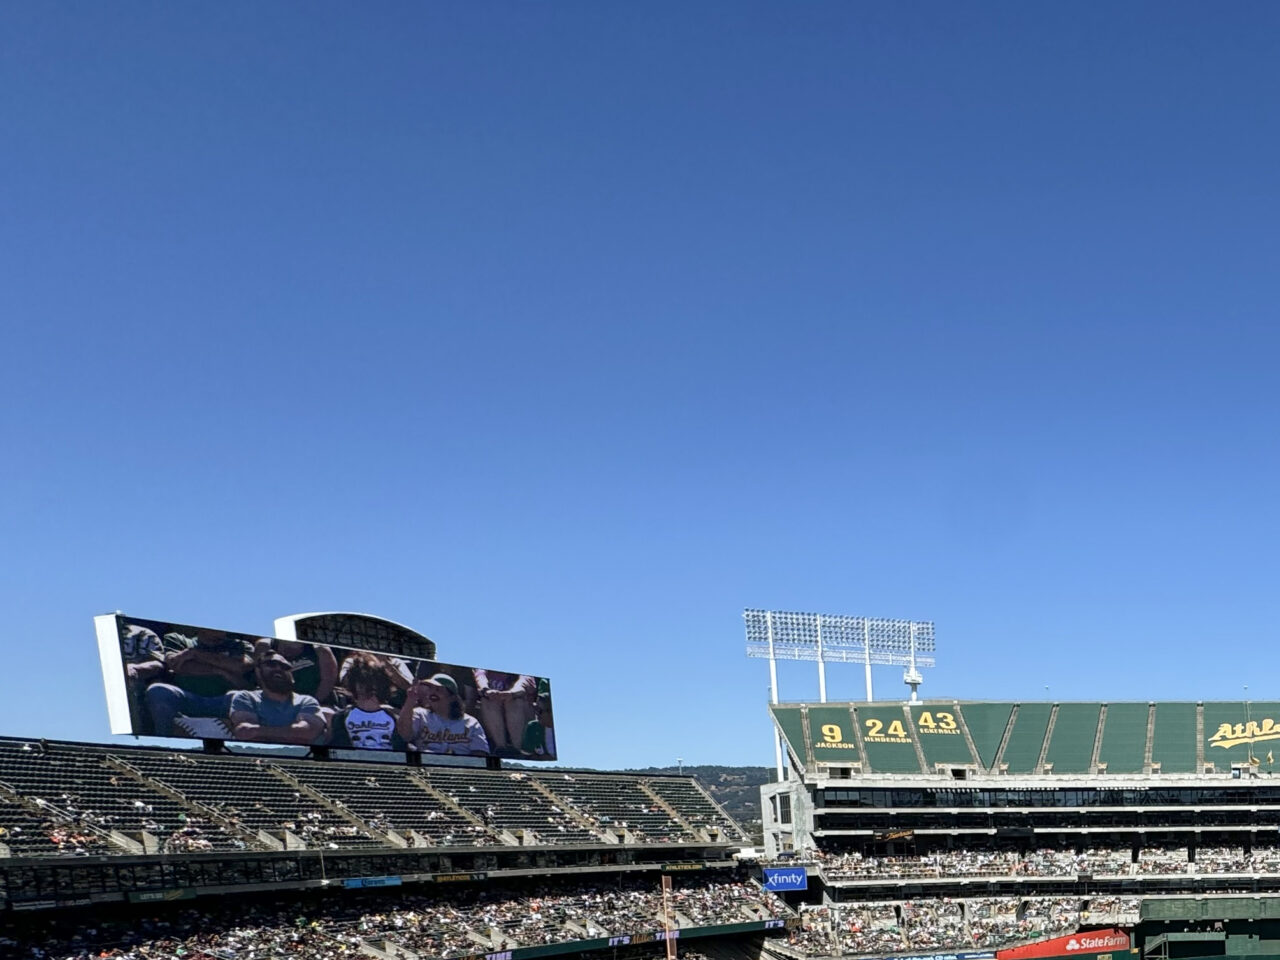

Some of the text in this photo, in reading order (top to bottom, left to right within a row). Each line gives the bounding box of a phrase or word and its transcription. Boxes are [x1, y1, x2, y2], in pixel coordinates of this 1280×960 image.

[865, 719, 907, 737] 24
[918, 712, 957, 729] 43
[419, 726, 471, 744] Oakland
[821, 724, 843, 743] 9
[768, 873, 803, 886] xfinity
[765, 920, 785, 928] IT'S
[609, 936, 630, 946] IT'S
[1080, 936, 1126, 950] State Farm
